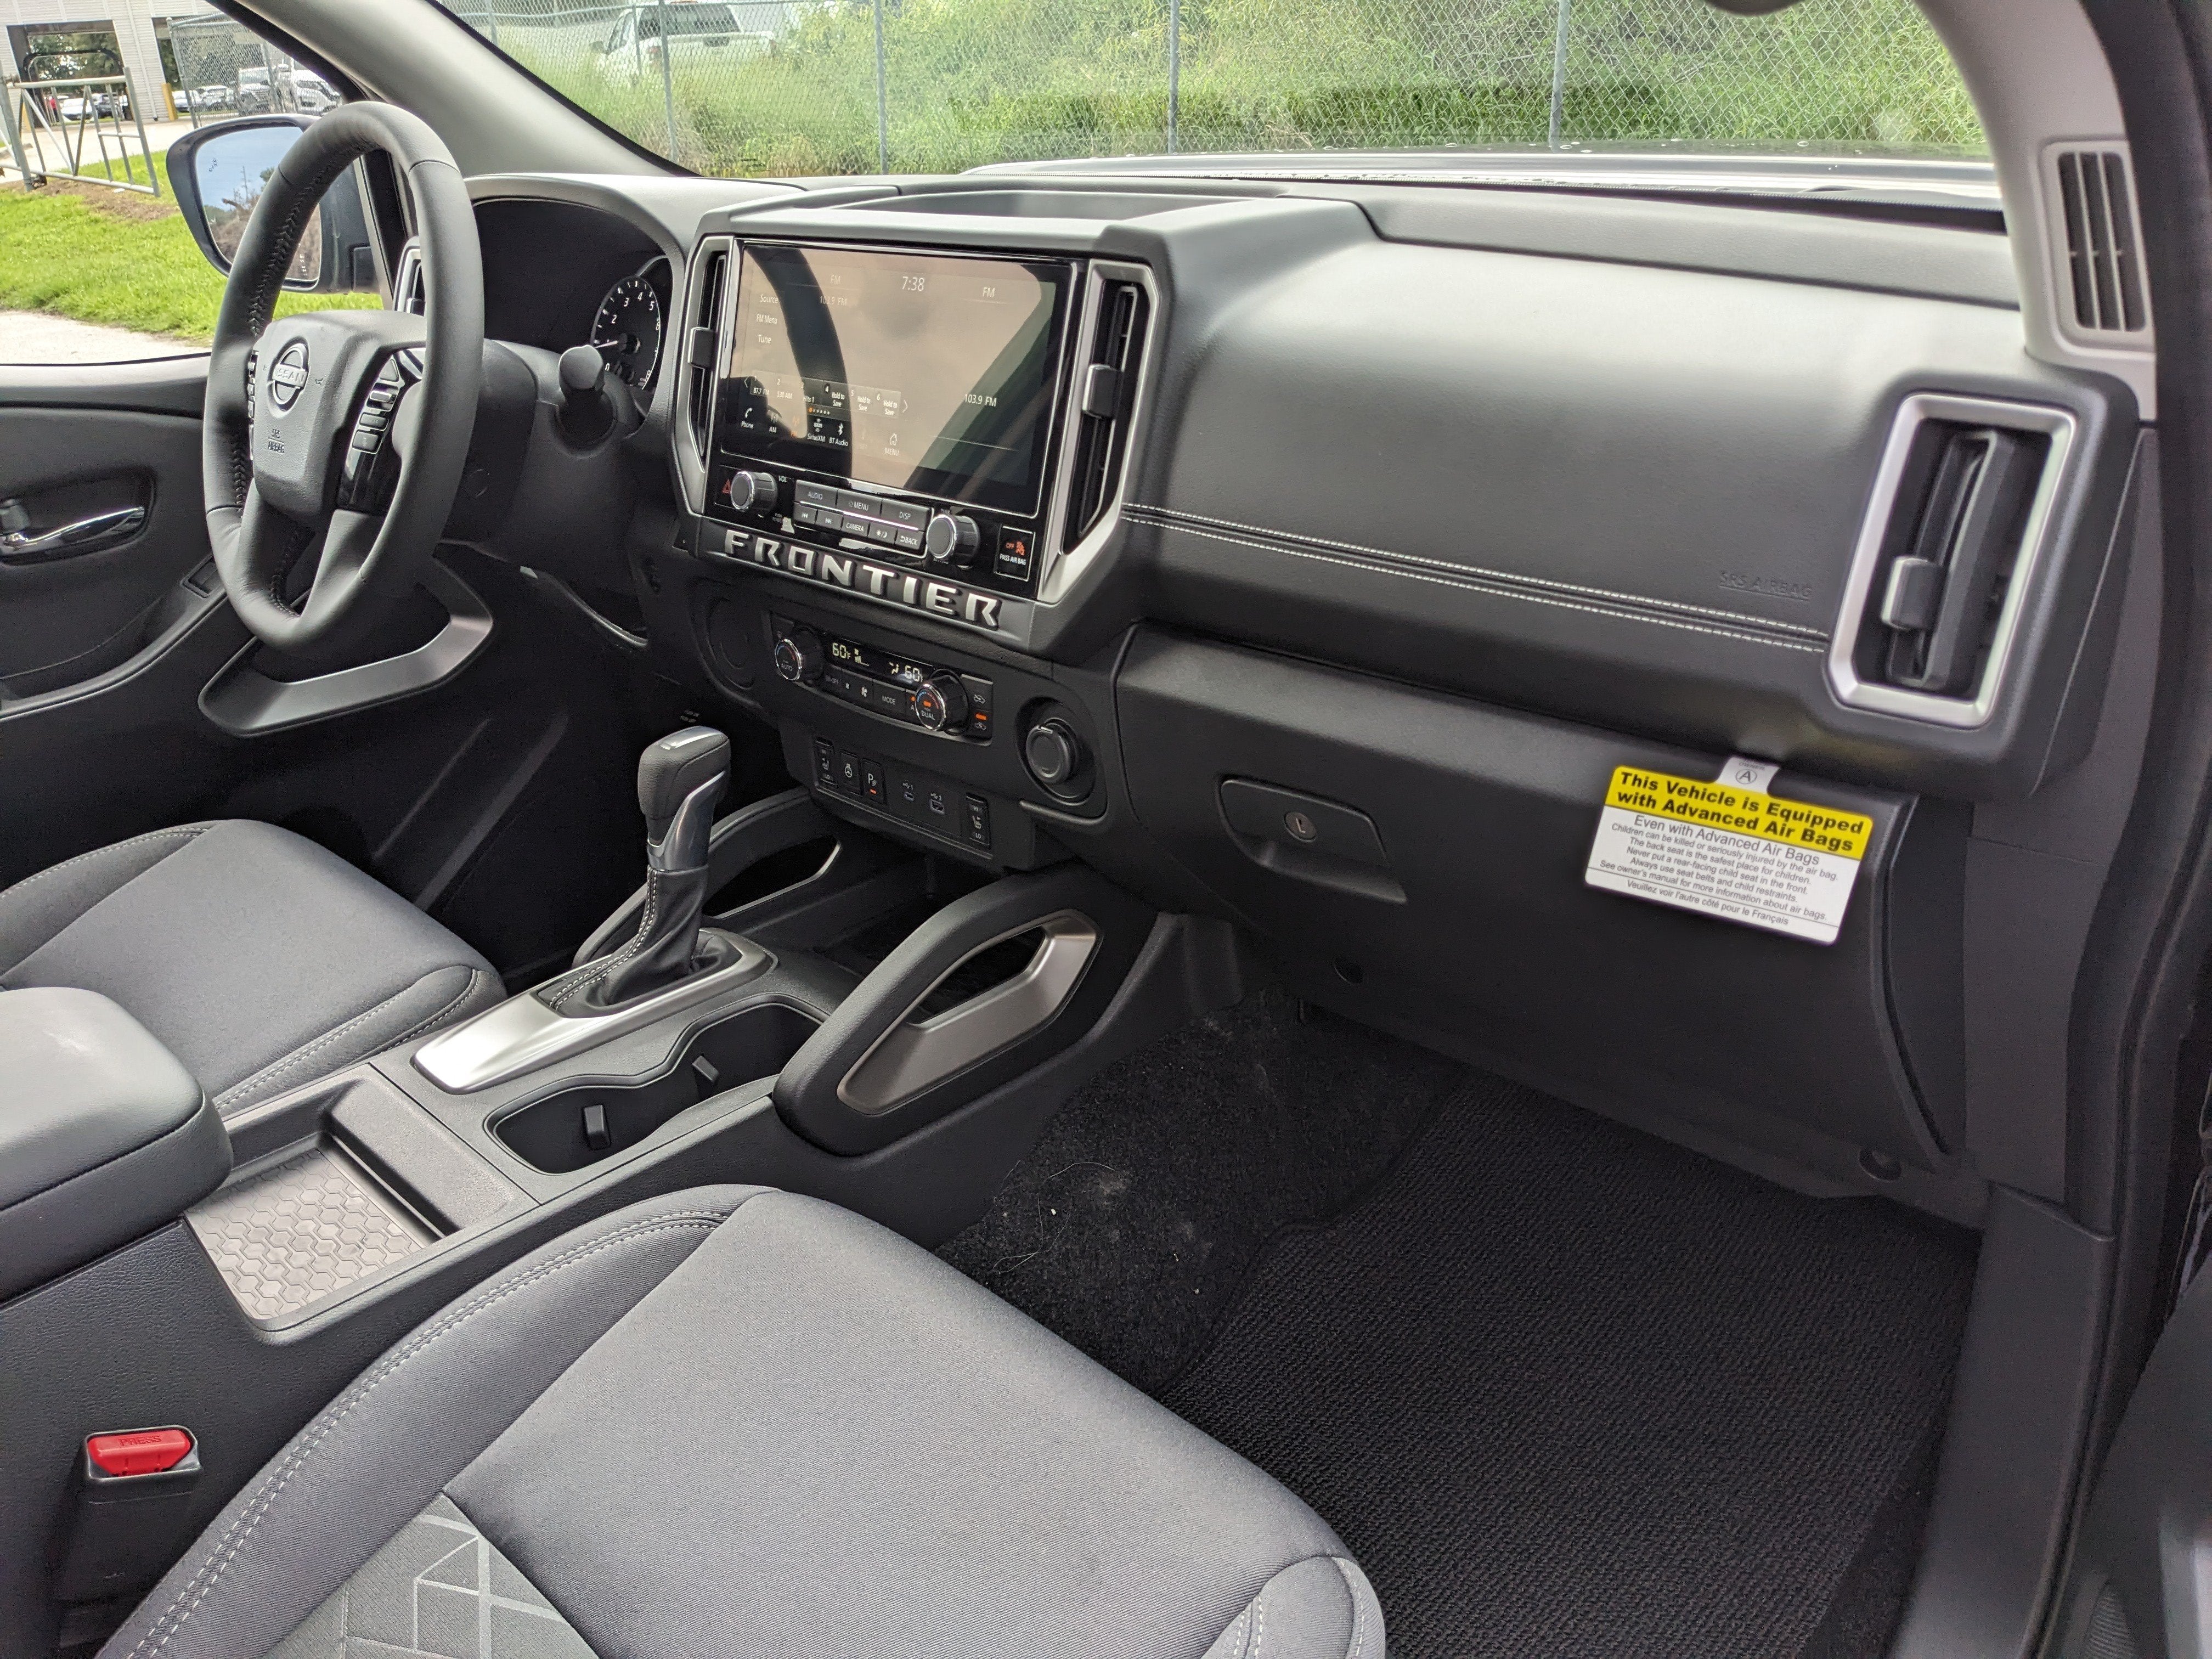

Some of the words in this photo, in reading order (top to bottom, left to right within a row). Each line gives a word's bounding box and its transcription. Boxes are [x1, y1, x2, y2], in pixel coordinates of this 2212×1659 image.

[901, 275, 926, 292] 7:38
[637, 291, 643, 301] 4
[983, 286, 996, 297] FM
[623, 297, 629, 307] 3
[760, 294, 779, 304] Source
[649, 301, 654, 311] 5
[611, 314, 617, 324] 2
[756, 313, 764, 323] FM
[764, 315, 778, 324] Menu
[758, 334, 772, 345] Tune
[964, 394, 982, 405] 103.9
[985, 396, 997, 407] FM
[741, 421, 754, 429] Phone
[807, 433, 826, 442] SiriusXM
[835, 438, 849, 447] Audio
[884, 448, 899, 456] MENU
[808, 492, 823, 500] AUDIO
[854, 502, 869, 511] MENU
[899, 511, 911, 520] DISP
[846, 522, 864, 532] CAMERA
[905, 537, 918, 545] BACK
[1000, 553, 1010, 562] PASS
[1017, 557, 1026, 566] BAG
[724, 529, 999, 627] FRONTIER
[882, 695, 895, 705] MODE
[921, 710, 935, 720] DUAL
[1622, 772, 1657, 790] This
[1667, 781, 1735, 806] Vehicle
[1742, 797, 1758, 811] is
[1767, 803, 1864, 833] Equipped
[1618, 792, 1656, 808] with
[1662, 799, 1758, 830] Advanced
[1764, 821, 1793, 837] Air
[1801, 828, 1852, 851] Bags
[1634, 814, 1664, 831] Even
[1669, 823, 1693, 837] with
[1695, 828, 1760, 851] Advanced
[1762, 843, 1782, 856] Air
[1785, 847, 1820, 865] Bags
[1611, 822, 1644, 837] Children
[1645, 832, 1660, 840] can
[1661, 833, 1672, 843] be
[1673, 836, 1696, 848] killed
[1707, 845, 1744, 860] seriously
[1745, 852, 1775, 865] injured
[1776, 859, 1787, 870] by
[1790, 863, 1803, 873] the
[1804, 866, 1818, 876] air
[1819, 869, 1838, 882] bag.
[1630, 836, 1645, 847] The
[1646, 840, 1665, 851] back
[1667, 847, 1685, 856] seat
[1685, 849, 1693, 857] is
[1695, 851, 1708, 861] the
[1709, 856, 1735, 867] safest
[1736, 861, 1759, 872] place
[1761, 866, 1774, 875] for
[1775, 870, 1812, 885] children.
[1626, 846, 1651, 857] Never
[1651, 853, 1665, 861] put
[1673, 858, 1717, 874] rear-facing
[1718, 867, 1739, 878] child
[1740, 873, 1758, 882] seat
[1770, 879, 1784, 888] the
[1786, 882, 1809, 895] front.
[1629, 857, 1658, 870] Always
[1660, 866, 1675, 874] use
[1676, 868, 1694, 878] seat
[1695, 871, 1715, 883] belts
[1717, 878, 1733, 887] and
[1734, 882, 1754, 892] child
[1756, 887, 1798, 902] restraints.
[1600, 860, 1616, 870] See
[1649, 872, 1679, 884] manual
[1680, 878, 1691, 887] for
[1692, 883, 1713, 893] more
[1715, 887, 1761, 904] information
[1763, 899, 1788, 910] about
[1803, 908, 1827, 921] bags.
[1627, 879, 1657, 894] Veuillez
[1659, 889, 1674, 897] voir
[1701, 899, 1719, 908] côté
[1720, 904, 1741, 913] pour
[1742, 907, 1750, 916] le
[1752, 909, 1789, 925] Français
[118, 1434, 162, 1447] PRESS
